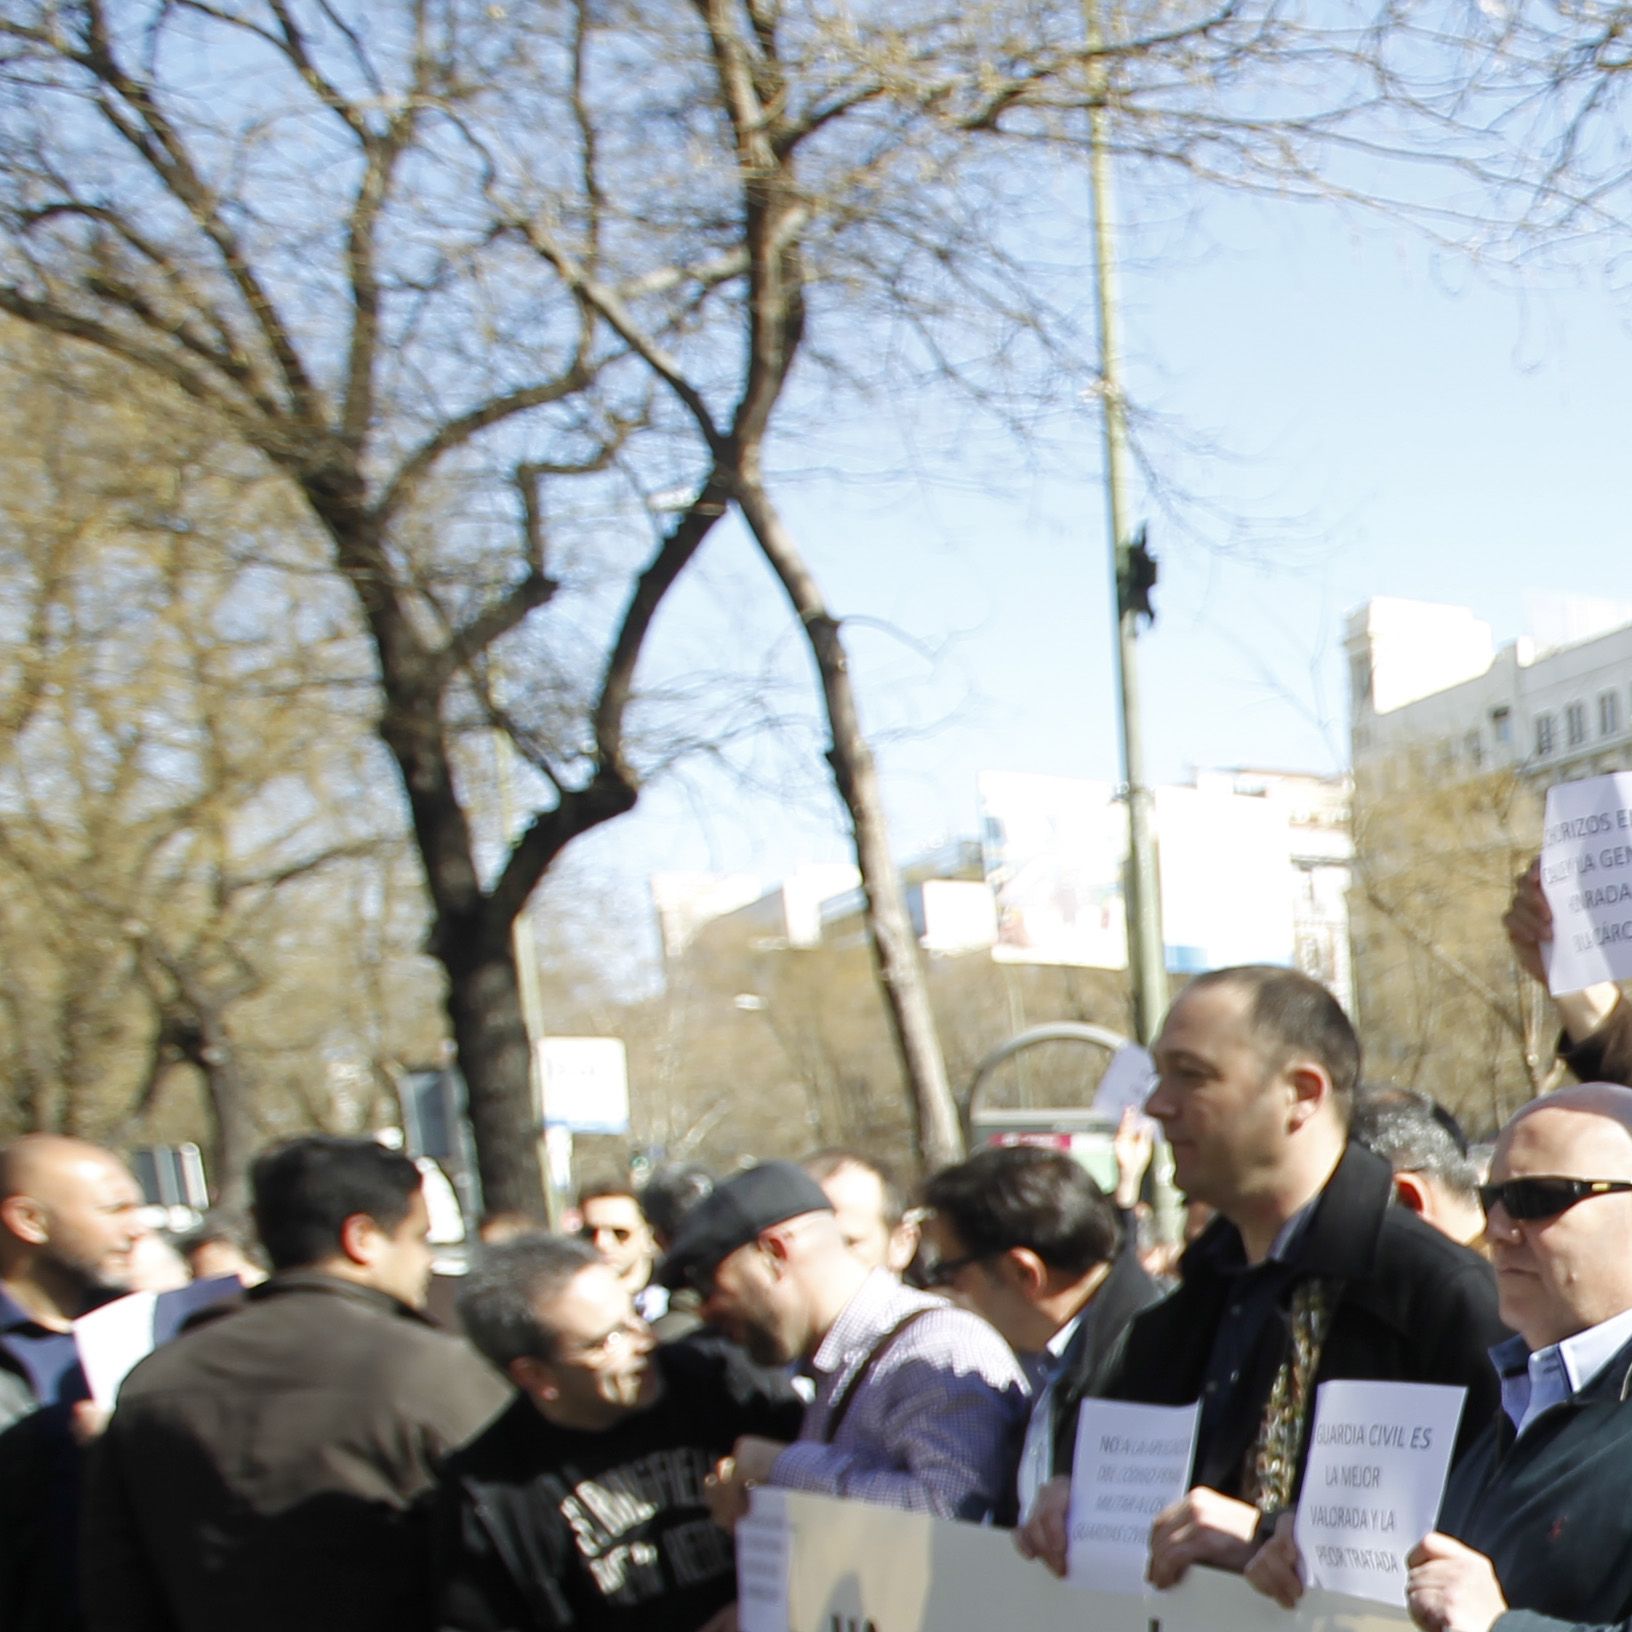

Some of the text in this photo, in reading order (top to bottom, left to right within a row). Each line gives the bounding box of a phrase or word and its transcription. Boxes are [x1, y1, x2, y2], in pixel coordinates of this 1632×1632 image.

[1317, 1423, 1433, 1450] GUARDIA CIVIL ES
[1325, 1465, 1380, 1488] LA MEJOR
[1310, 1506, 1395, 1532] VALORADA Y LA
[1349, 1549, 1399, 1574] TRATADA
